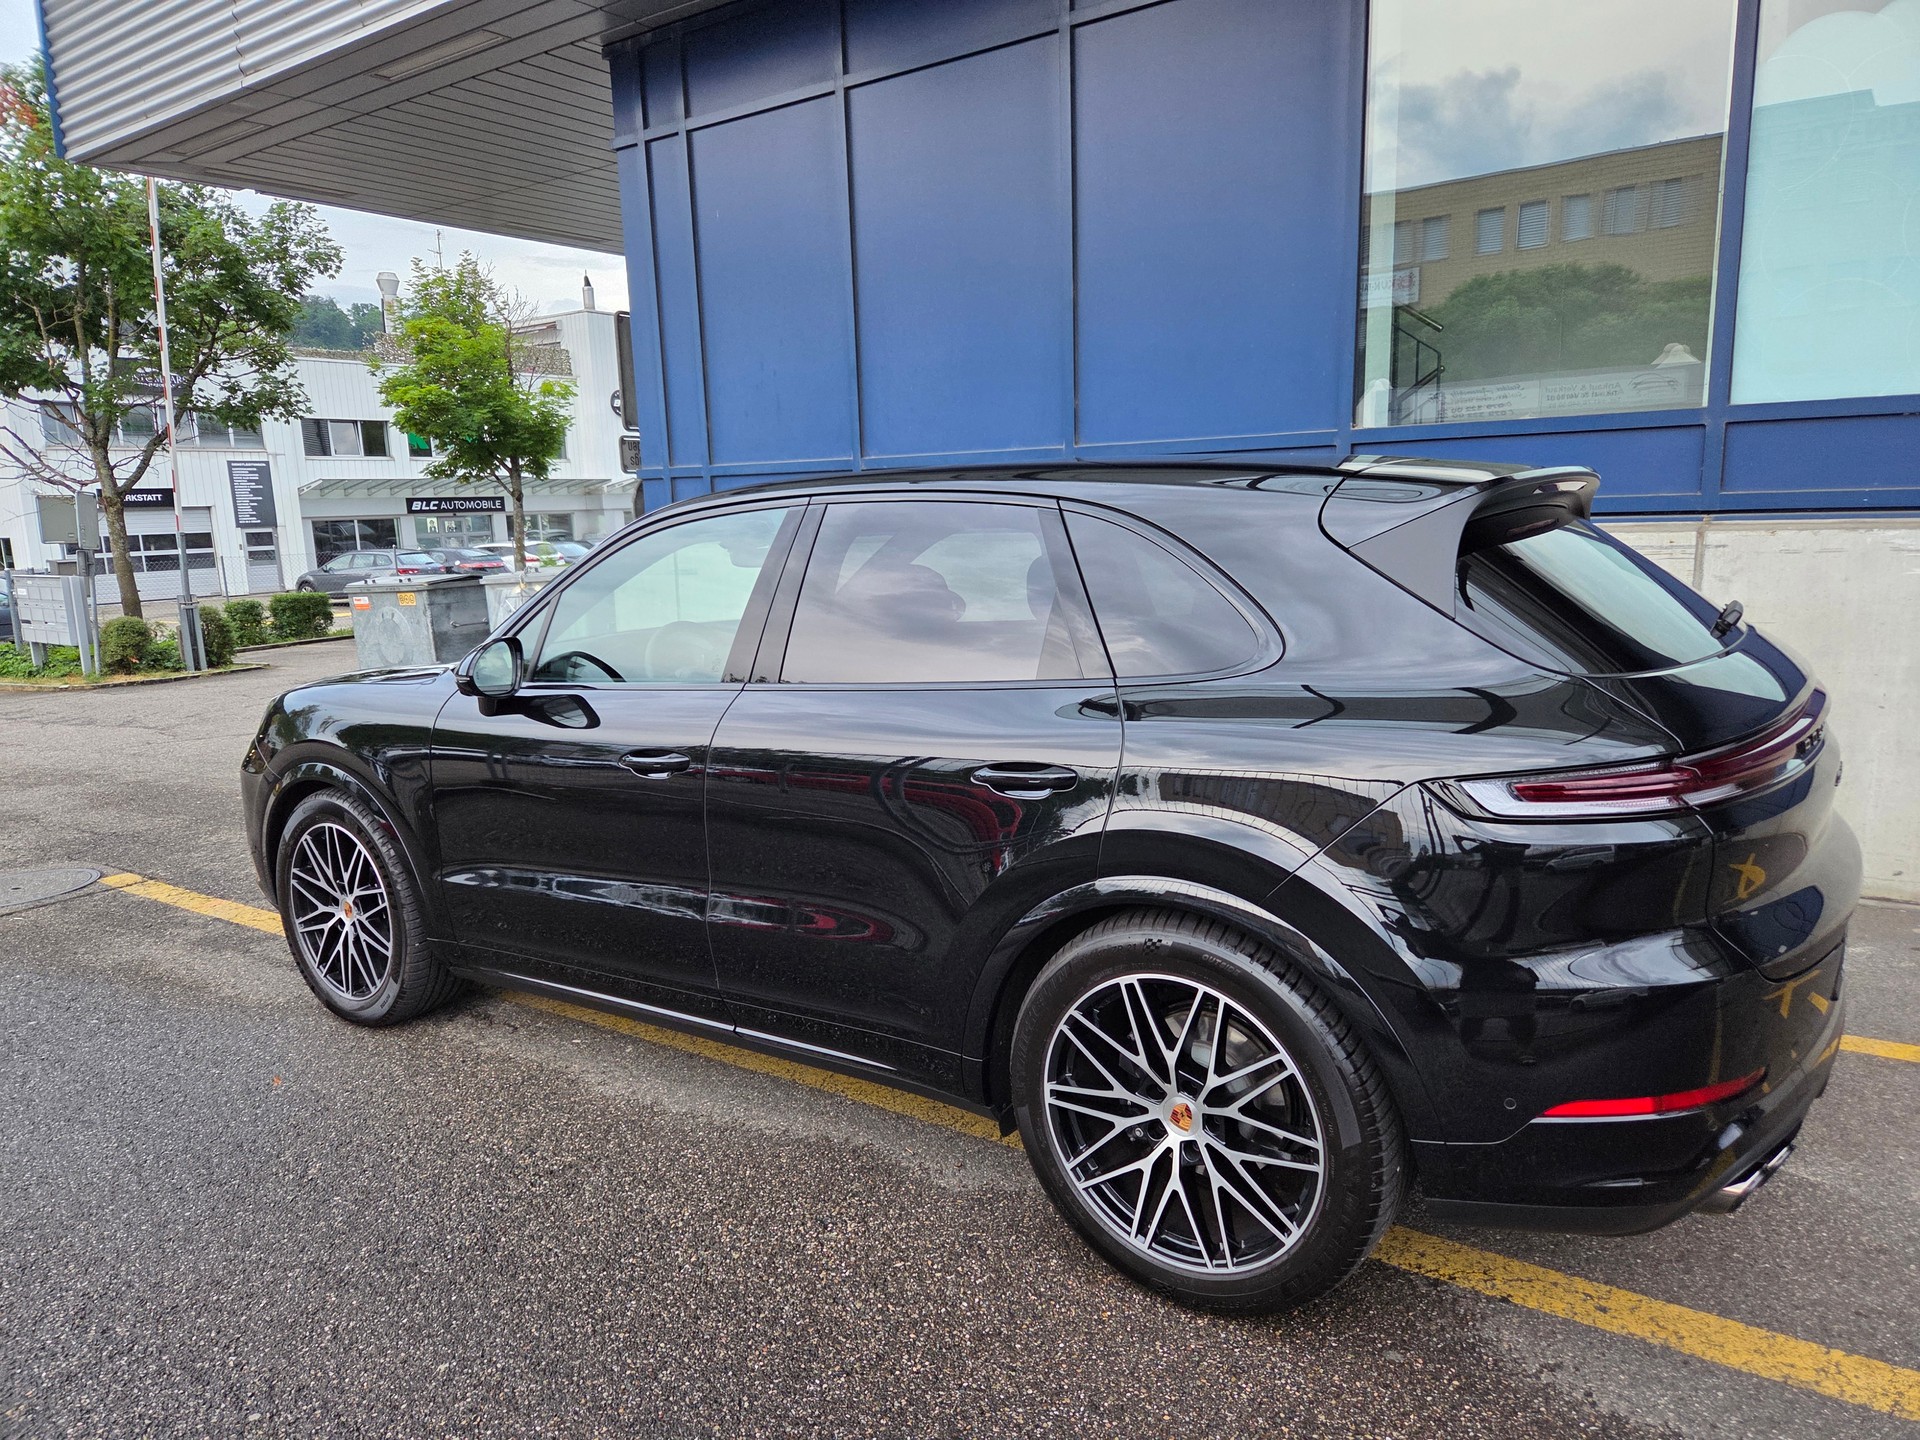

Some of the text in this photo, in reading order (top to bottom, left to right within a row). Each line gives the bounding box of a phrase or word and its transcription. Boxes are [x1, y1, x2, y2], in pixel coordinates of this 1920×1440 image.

[124, 494, 163, 502] RKSTATT
[411, 500, 502, 511] BLC AUTOMOBILE
[1201, 953, 1242, 975] OUTSIDE
